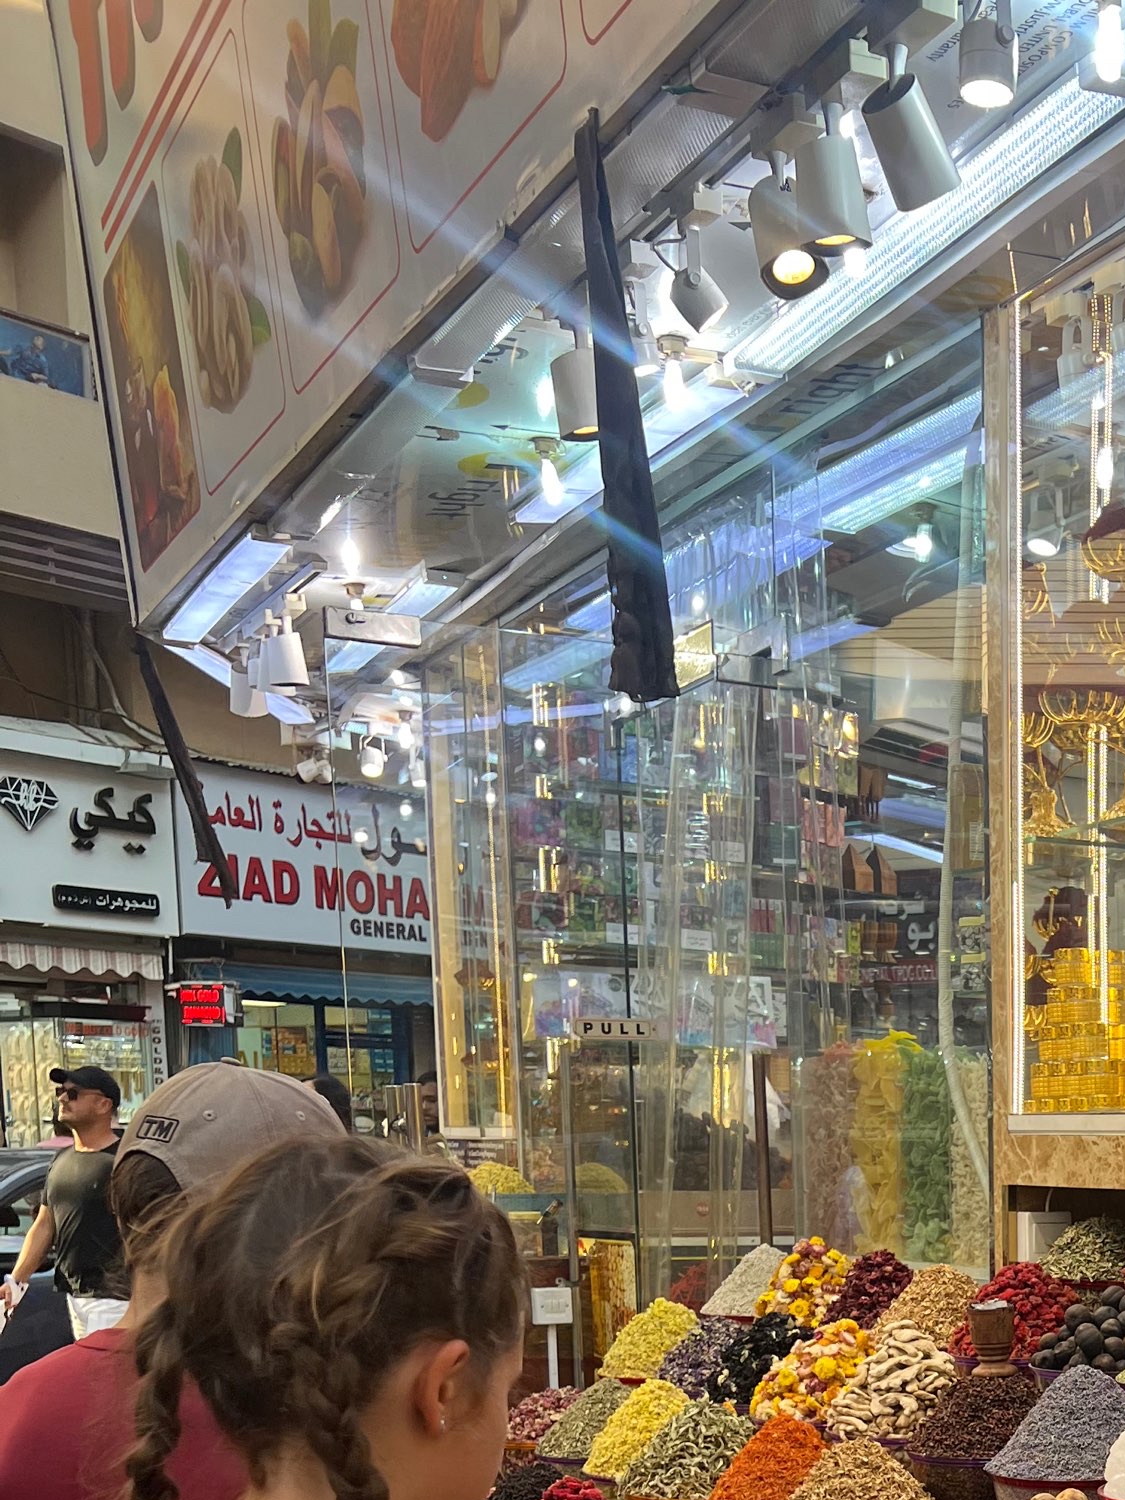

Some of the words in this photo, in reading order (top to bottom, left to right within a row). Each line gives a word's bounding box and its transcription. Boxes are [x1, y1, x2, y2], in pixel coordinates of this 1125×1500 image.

[926, 30, 961, 62] arranty
[1018, 31, 1073, 77] COMPOSIT
[69, 787, 156, 855] كيكي
[207, 791, 262, 832] العام
[273, 799, 352, 850] للتجارة
[360, 803, 428, 866] ول
[95, 893, 157, 911] للمجوهرات
[313, 864, 430, 921] MOHA
[350, 918, 428, 942] GENERAL
[583, 1022, 646, 1035] PULL
[144, 1118, 174, 1139] TM
